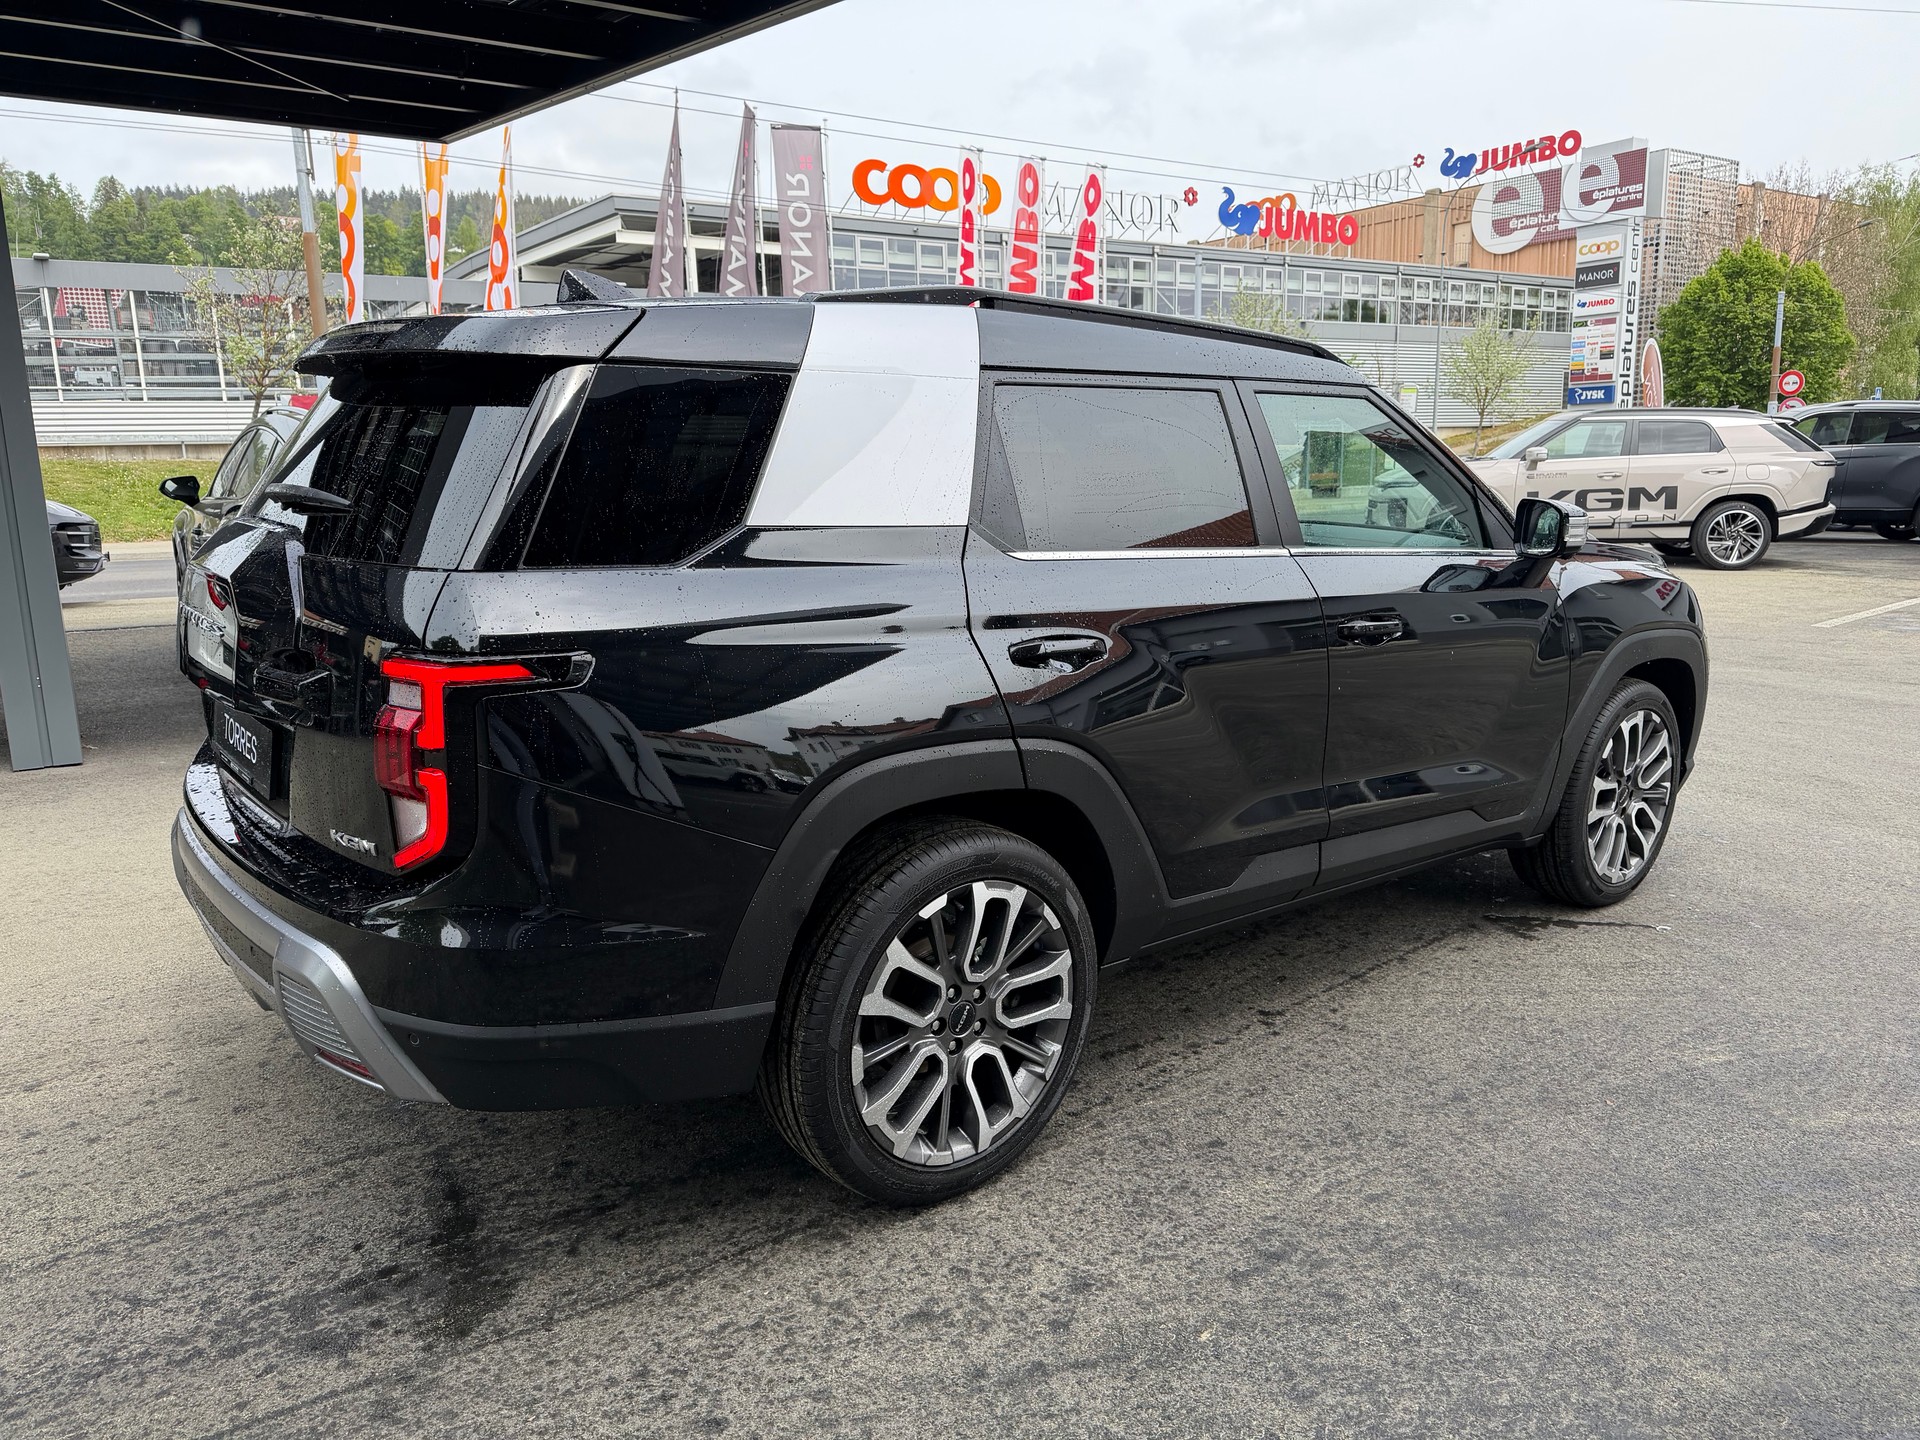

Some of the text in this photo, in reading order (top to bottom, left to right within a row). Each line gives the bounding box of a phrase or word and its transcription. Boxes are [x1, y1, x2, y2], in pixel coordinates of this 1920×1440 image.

[1475, 129, 1582, 175] JUMBO
[1311, 164, 1412, 209] MANOR
[1592, 183, 1644, 200] éplatures
[1616, 192, 1643, 203] centre
[1258, 206, 1359, 246] JUMBO
[1509, 212, 1560, 230] éplatur
[1540, 223, 1559, 233] cen
[1578, 239, 1620, 256] coop
[1630, 215, 1641, 273] centr
[1578, 269, 1614, 282] MANOR
[1586, 298, 1615, 308] JUMBO
[1580, 389, 1605, 400] JYSK
[223, 712, 258, 764] TORRES
[329, 828, 378, 857] KGM
